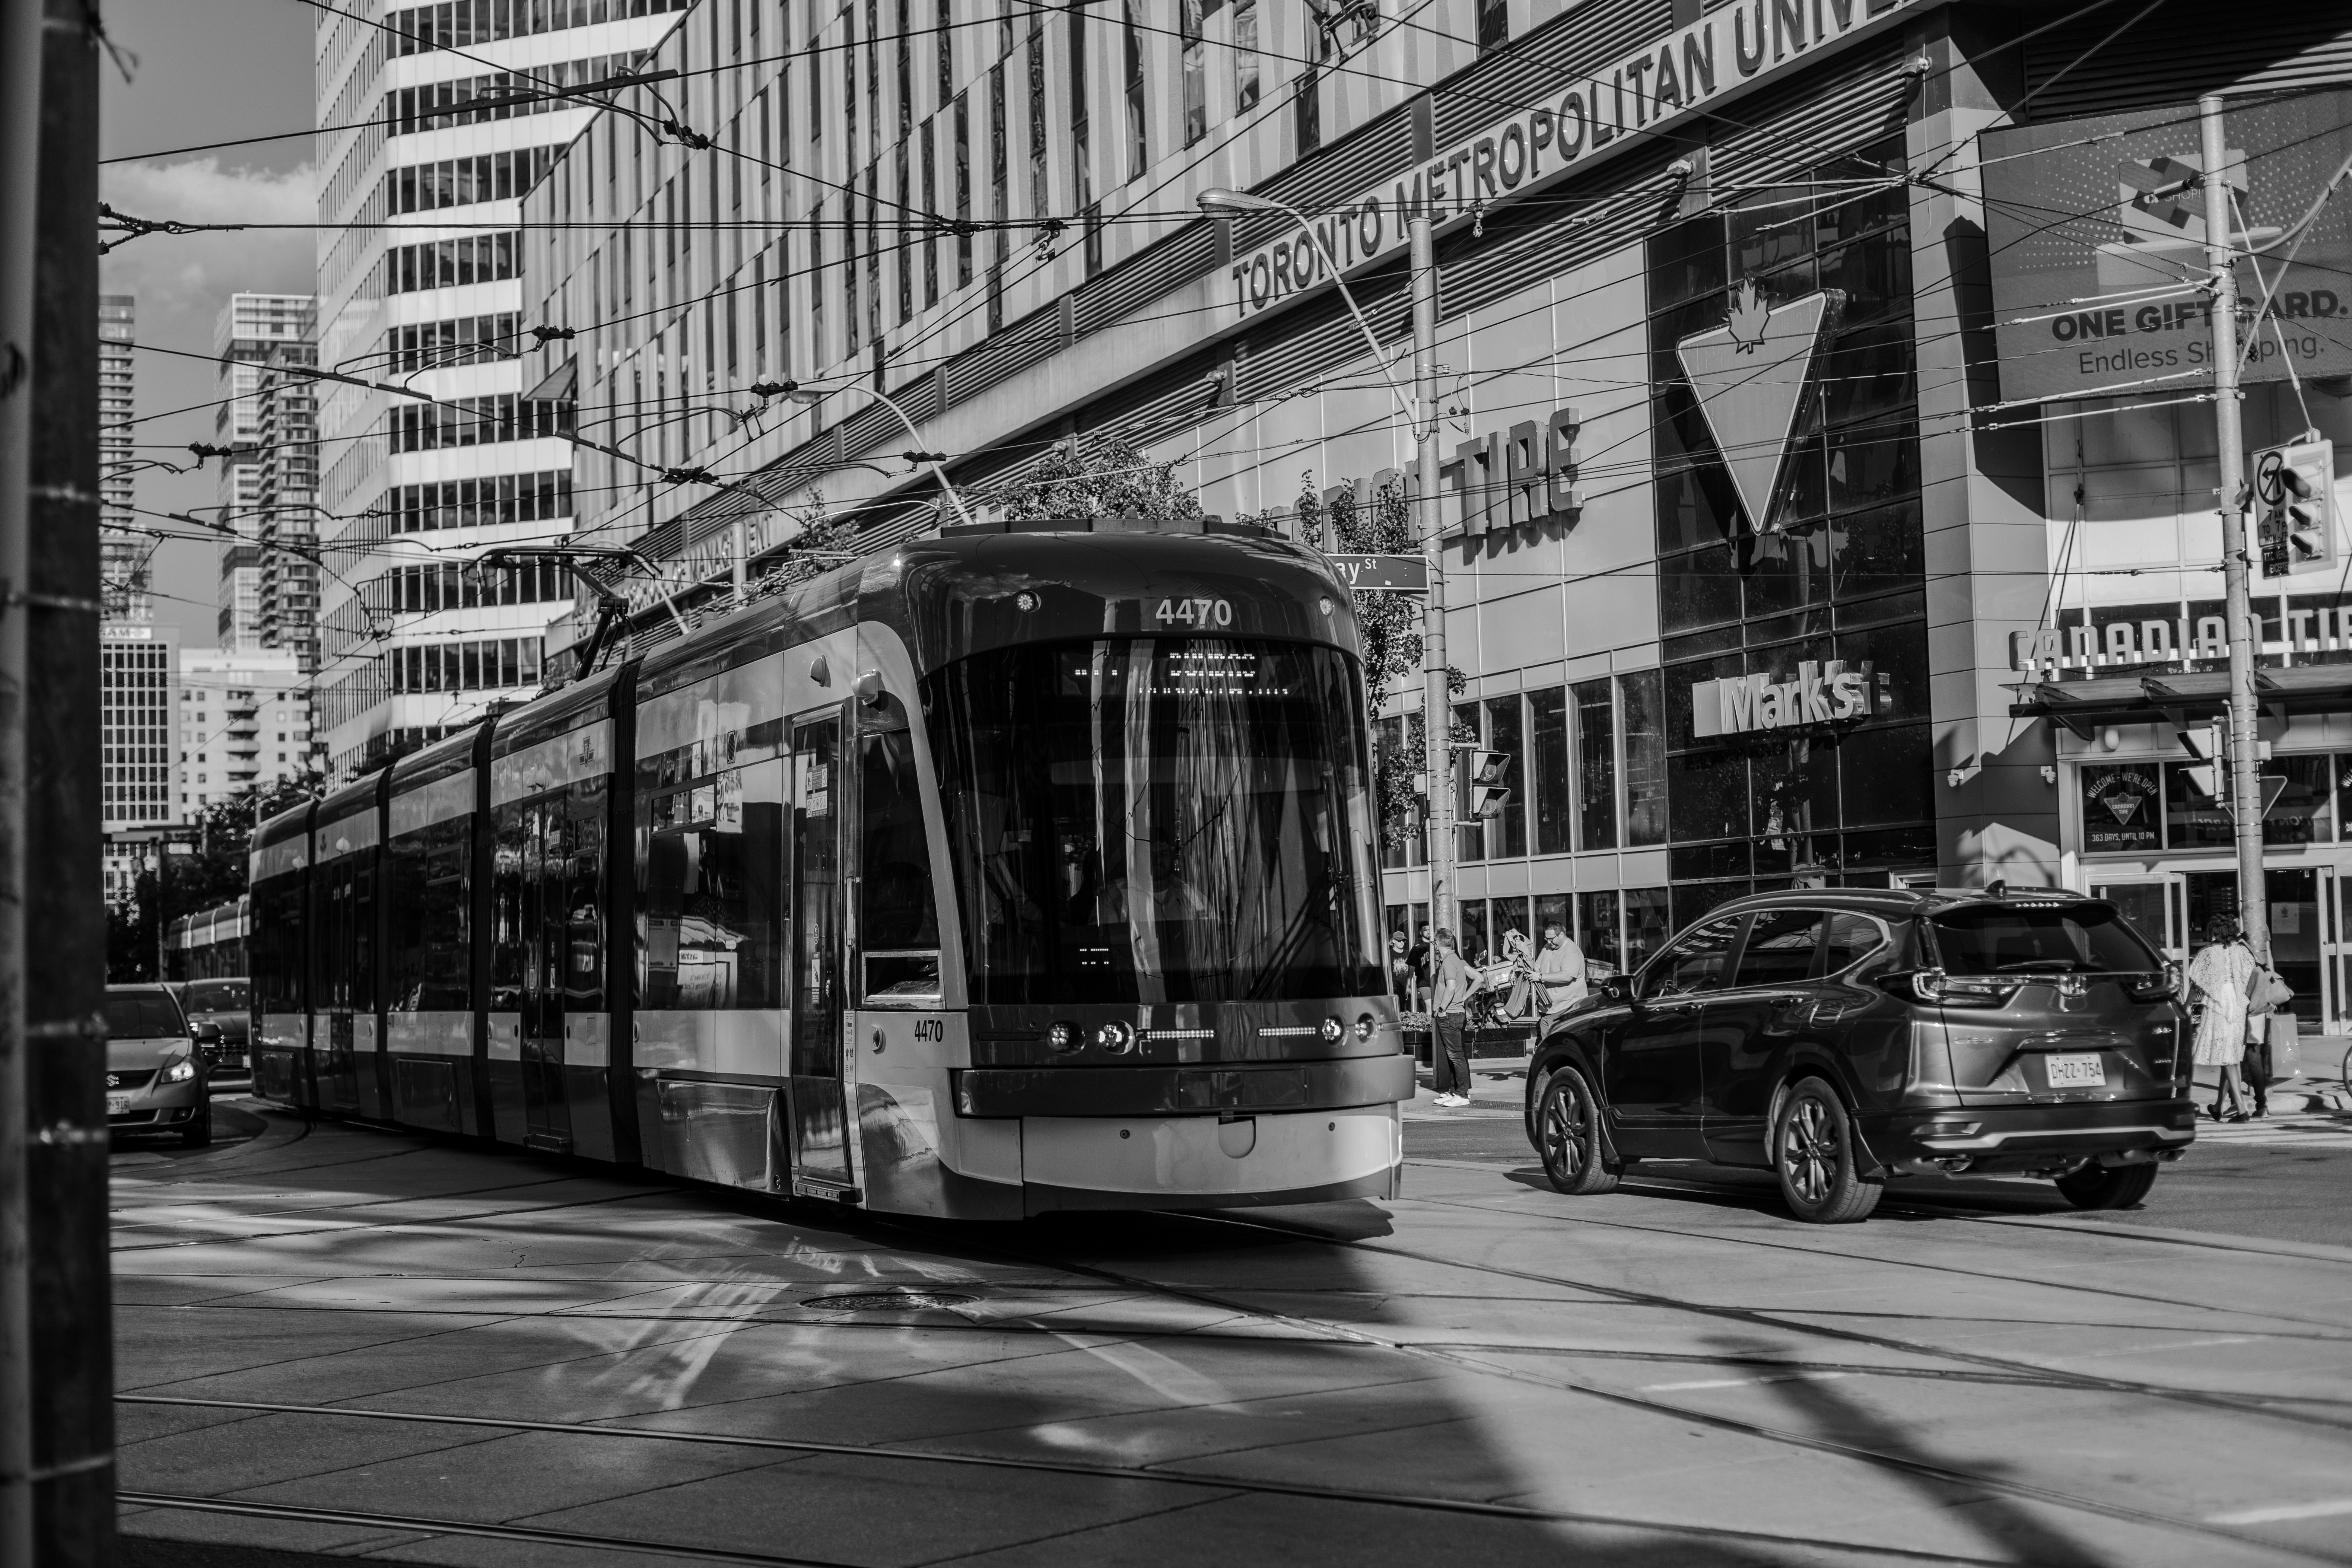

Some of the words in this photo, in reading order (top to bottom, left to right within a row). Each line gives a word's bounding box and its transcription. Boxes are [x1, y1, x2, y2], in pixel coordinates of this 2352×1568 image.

[1233, 195, 1383, 318] TORONTO
[1396, 22, 1717, 243] METROPOLITAN
[1734, 0, 1901, 77] UNI
[2052, 310, 2125, 342] ONE
[2135, 299, 2212, 333] GIFT
[2079, 348, 2178, 374] Endless
[2187, 336, 2325, 364] Shping.
[1456, 407, 1583, 537] TIRE
[2263, 524, 2270, 534] TO
[2276, 520, 2281, 532] 7
[2282, 521, 2288, 531] P
[2267, 509, 2273, 521] 7
[2275, 509, 2284, 519] AM
[2265, 534, 2276, 543] MON
[1335, 562, 1360, 583] ay
[1365, 558, 1377, 569] St
[2270, 561, 2289, 573] EXCEPTE
[1156, 599, 1232, 626] 4470
[1721, 660, 1863, 733] Mark's
[2087, 774, 2116, 798] WELCOME
[2121, 772, 2142, 784] WE'RE
[2141, 778, 2159, 796] OPEN
[2092, 834, 2103, 842] 363
[2105, 833, 2120, 842] DAYS,
[2122, 832, 2137, 841] UNTIL
[914, 1020, 943, 1043] 4470
[2082, 1062, 2102, 1078] 754
[115, 1101, 128, 1110] 916
